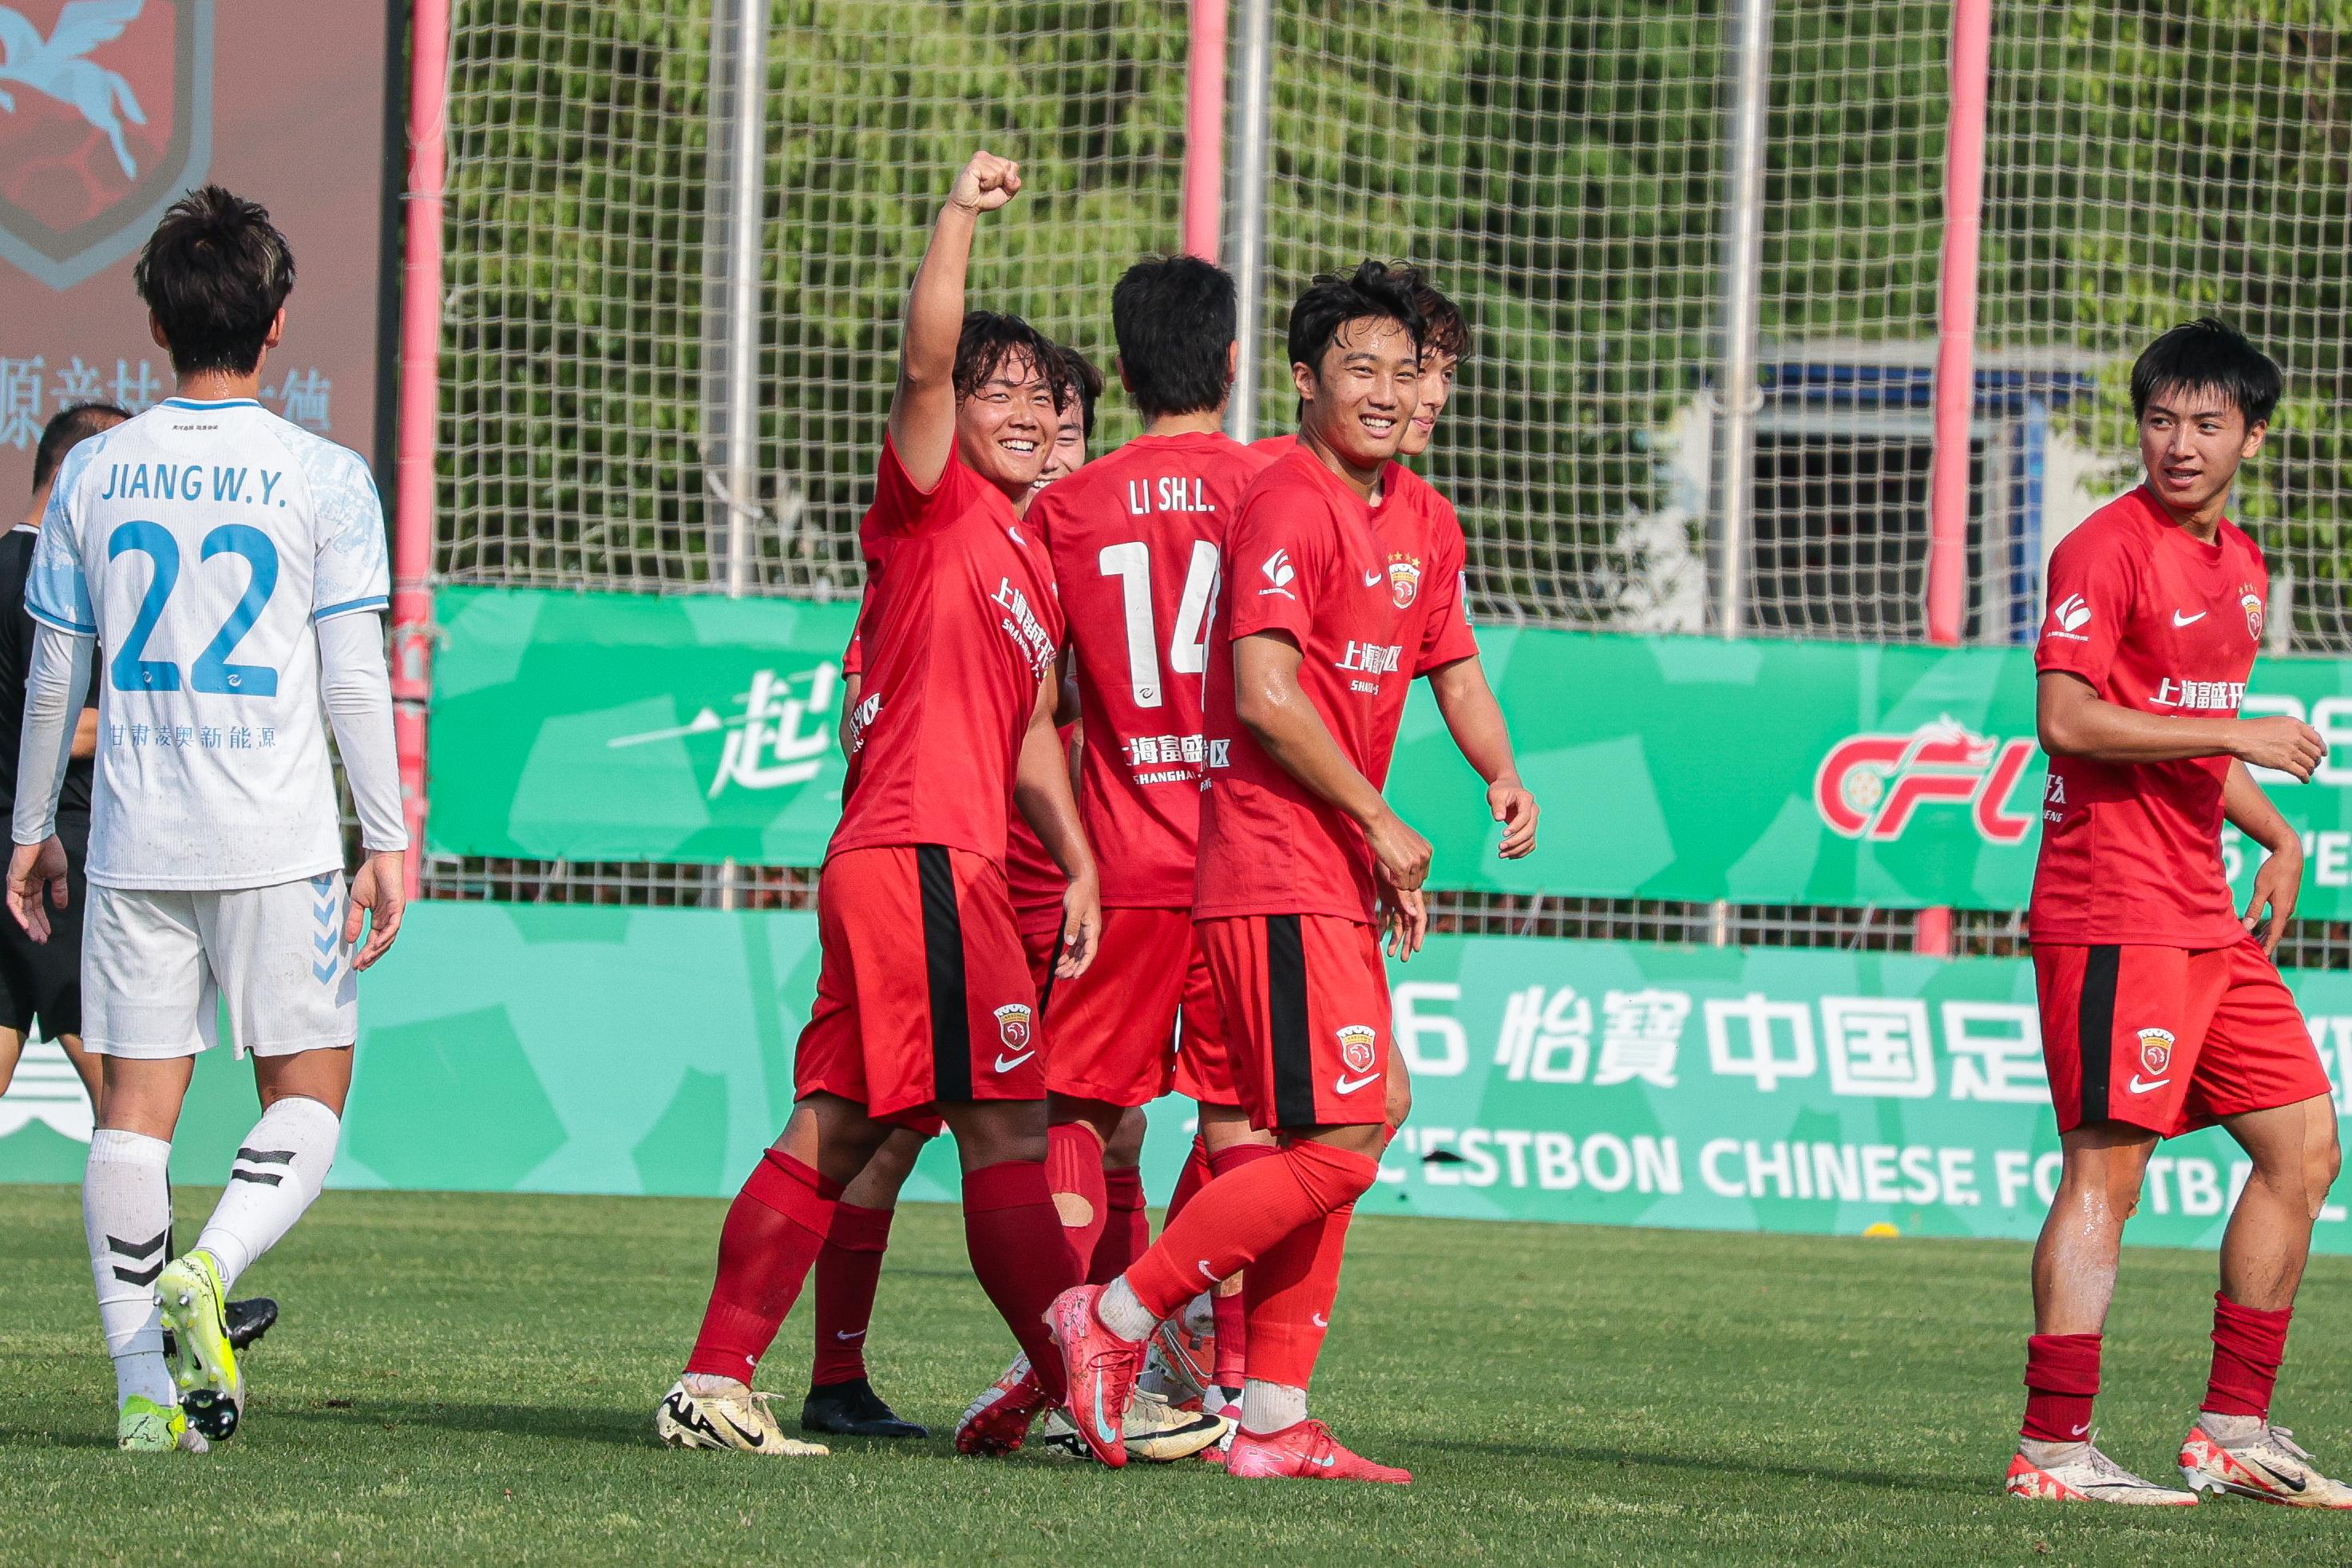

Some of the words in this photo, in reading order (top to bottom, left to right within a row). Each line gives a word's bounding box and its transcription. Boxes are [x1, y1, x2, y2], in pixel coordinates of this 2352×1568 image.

[102, 463, 203, 501] JIANG
[212, 465, 287, 508] W.Y.
[1129, 478, 1150, 515] LI
[1158, 476, 1216, 512] SH.L.
[107, 520, 279, 698] 22
[1099, 539, 1222, 710] 14
[111, 723, 276, 749] 甘肃凌奥新能源
[607, 661, 837, 798] 一起
[1812, 713, 2038, 845] CFL
[1701, 1138, 1980, 1206] CHINESE
